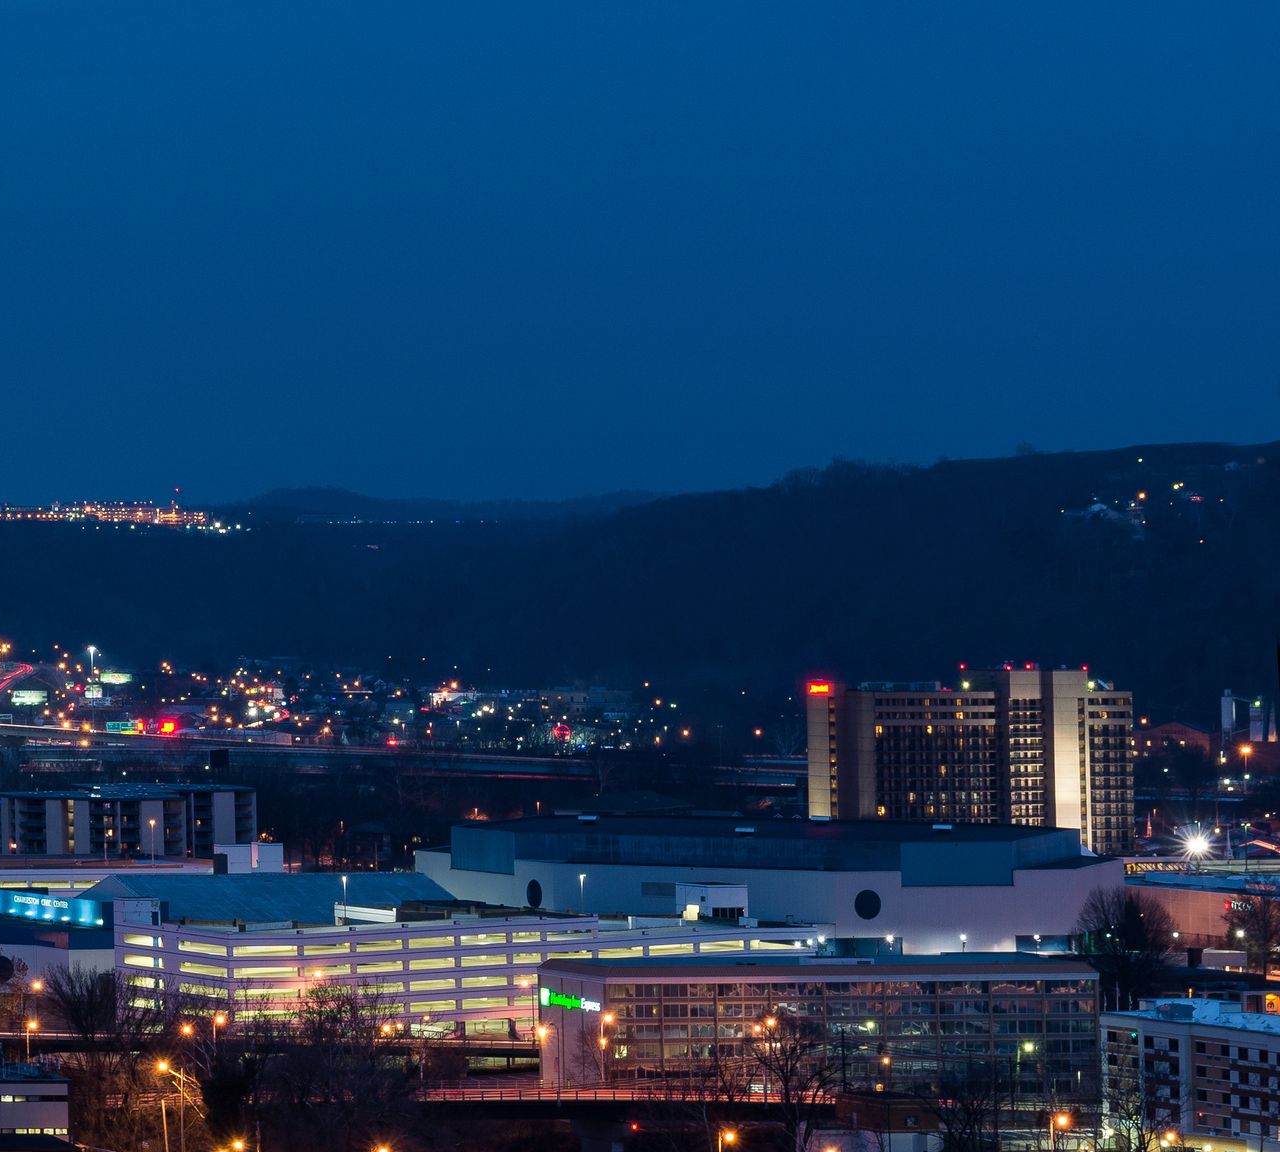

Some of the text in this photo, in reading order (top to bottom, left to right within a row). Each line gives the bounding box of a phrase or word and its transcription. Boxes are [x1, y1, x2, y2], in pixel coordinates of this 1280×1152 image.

[14, 895, 68, 909] CHARLESTON CIVIC CENTER
